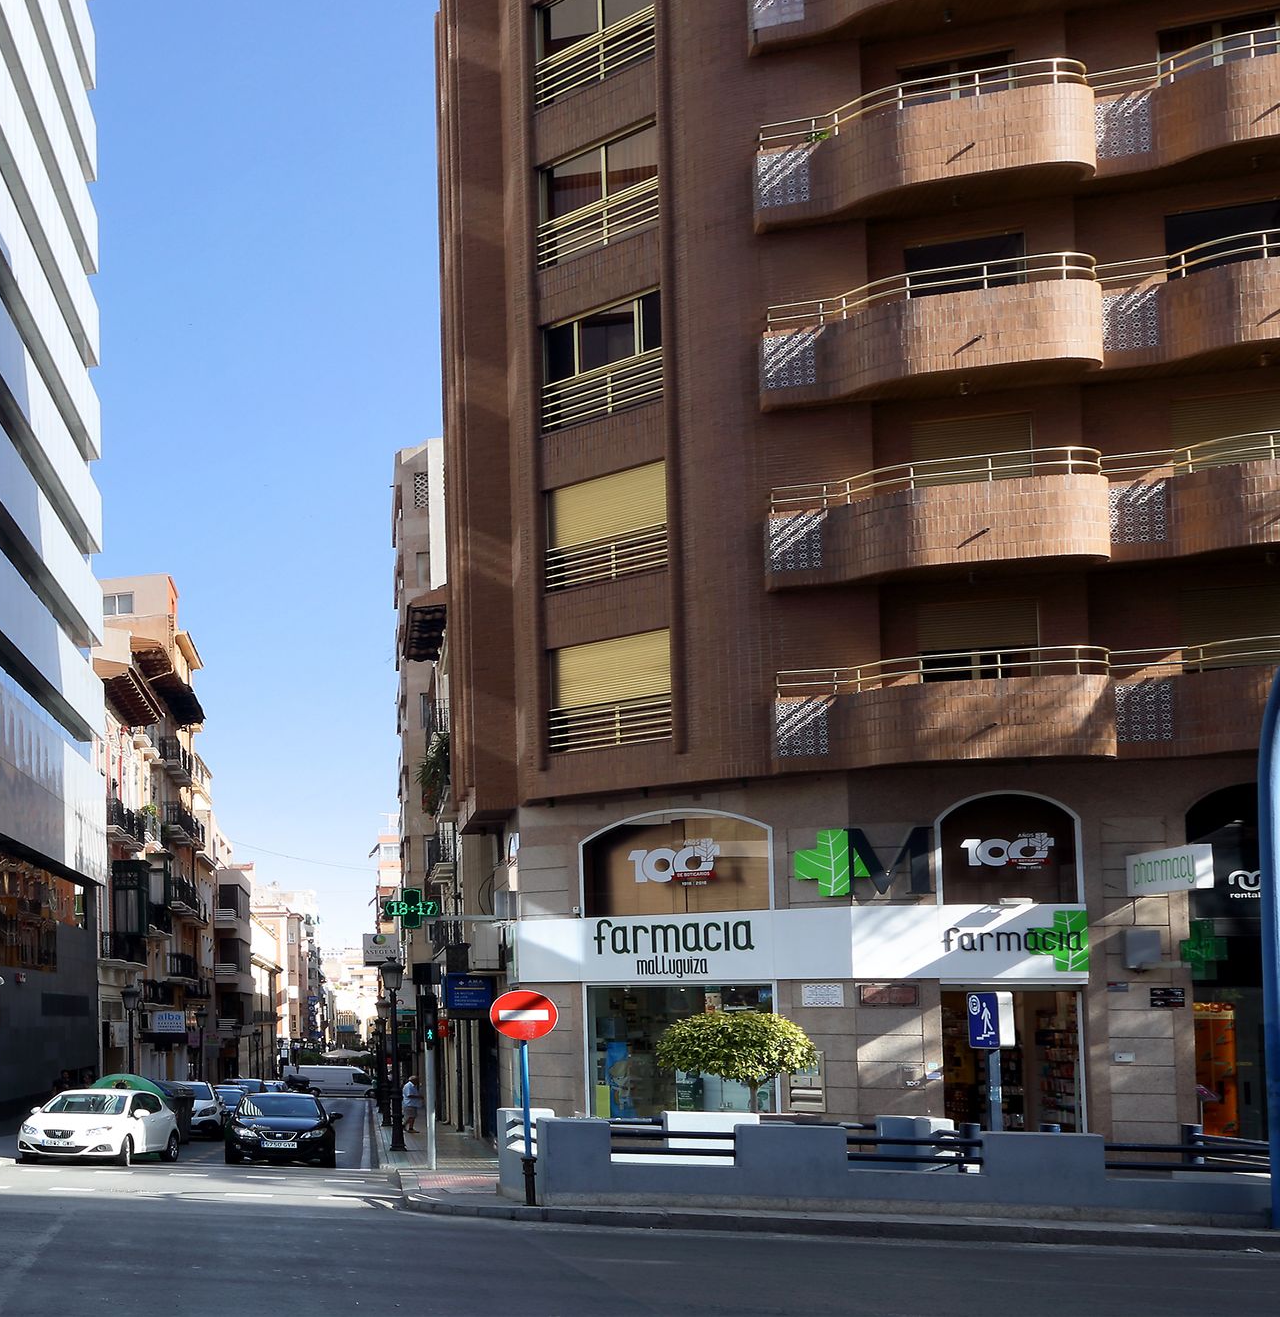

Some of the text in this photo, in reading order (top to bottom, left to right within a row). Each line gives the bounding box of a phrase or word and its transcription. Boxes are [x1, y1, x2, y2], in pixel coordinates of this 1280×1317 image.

[1133, 852, 1196, 888] pharmacy
[391, 901, 434, 916] 18:17
[593, 919, 755, 955] farmacia
[636, 955, 709, 979] malluguiza
[158, 1012, 181, 1021] alba
